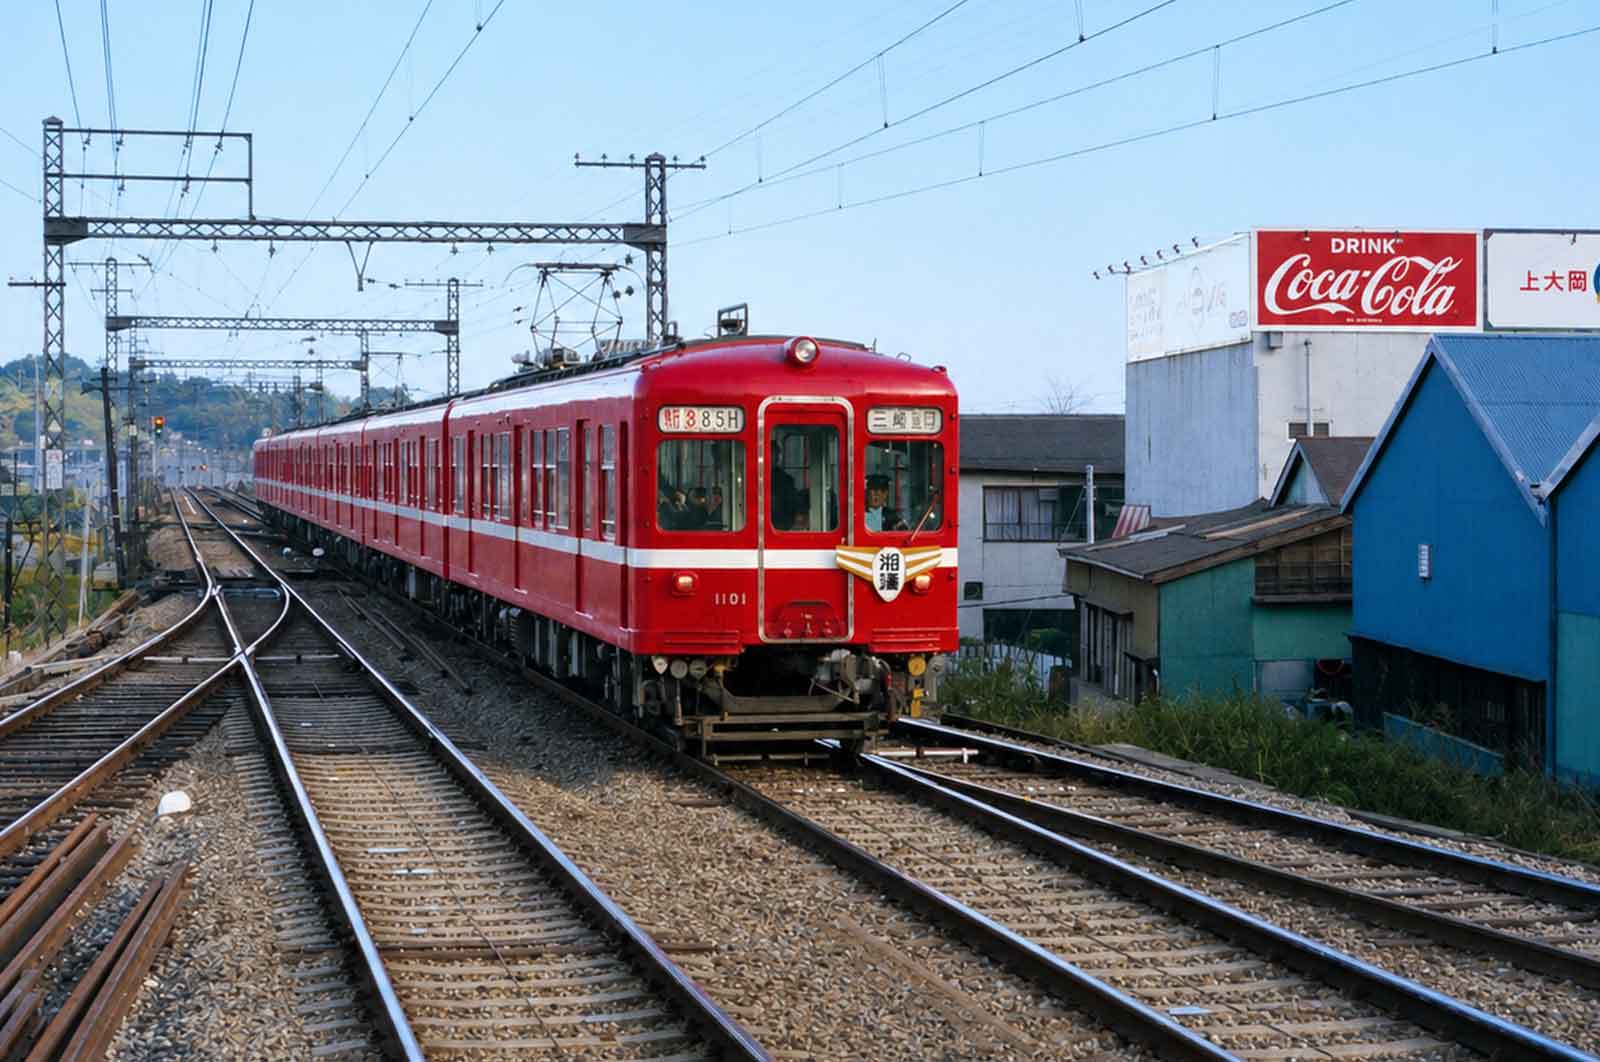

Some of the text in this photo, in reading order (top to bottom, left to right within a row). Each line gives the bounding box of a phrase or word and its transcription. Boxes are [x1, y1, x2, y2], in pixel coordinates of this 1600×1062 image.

[1331, 237, 1396, 254] DRINK
[1264, 253, 1463, 315] Coca-Cola
[1519, 269, 1587, 293] 上大岡
[714, 591, 747, 606] 1101
